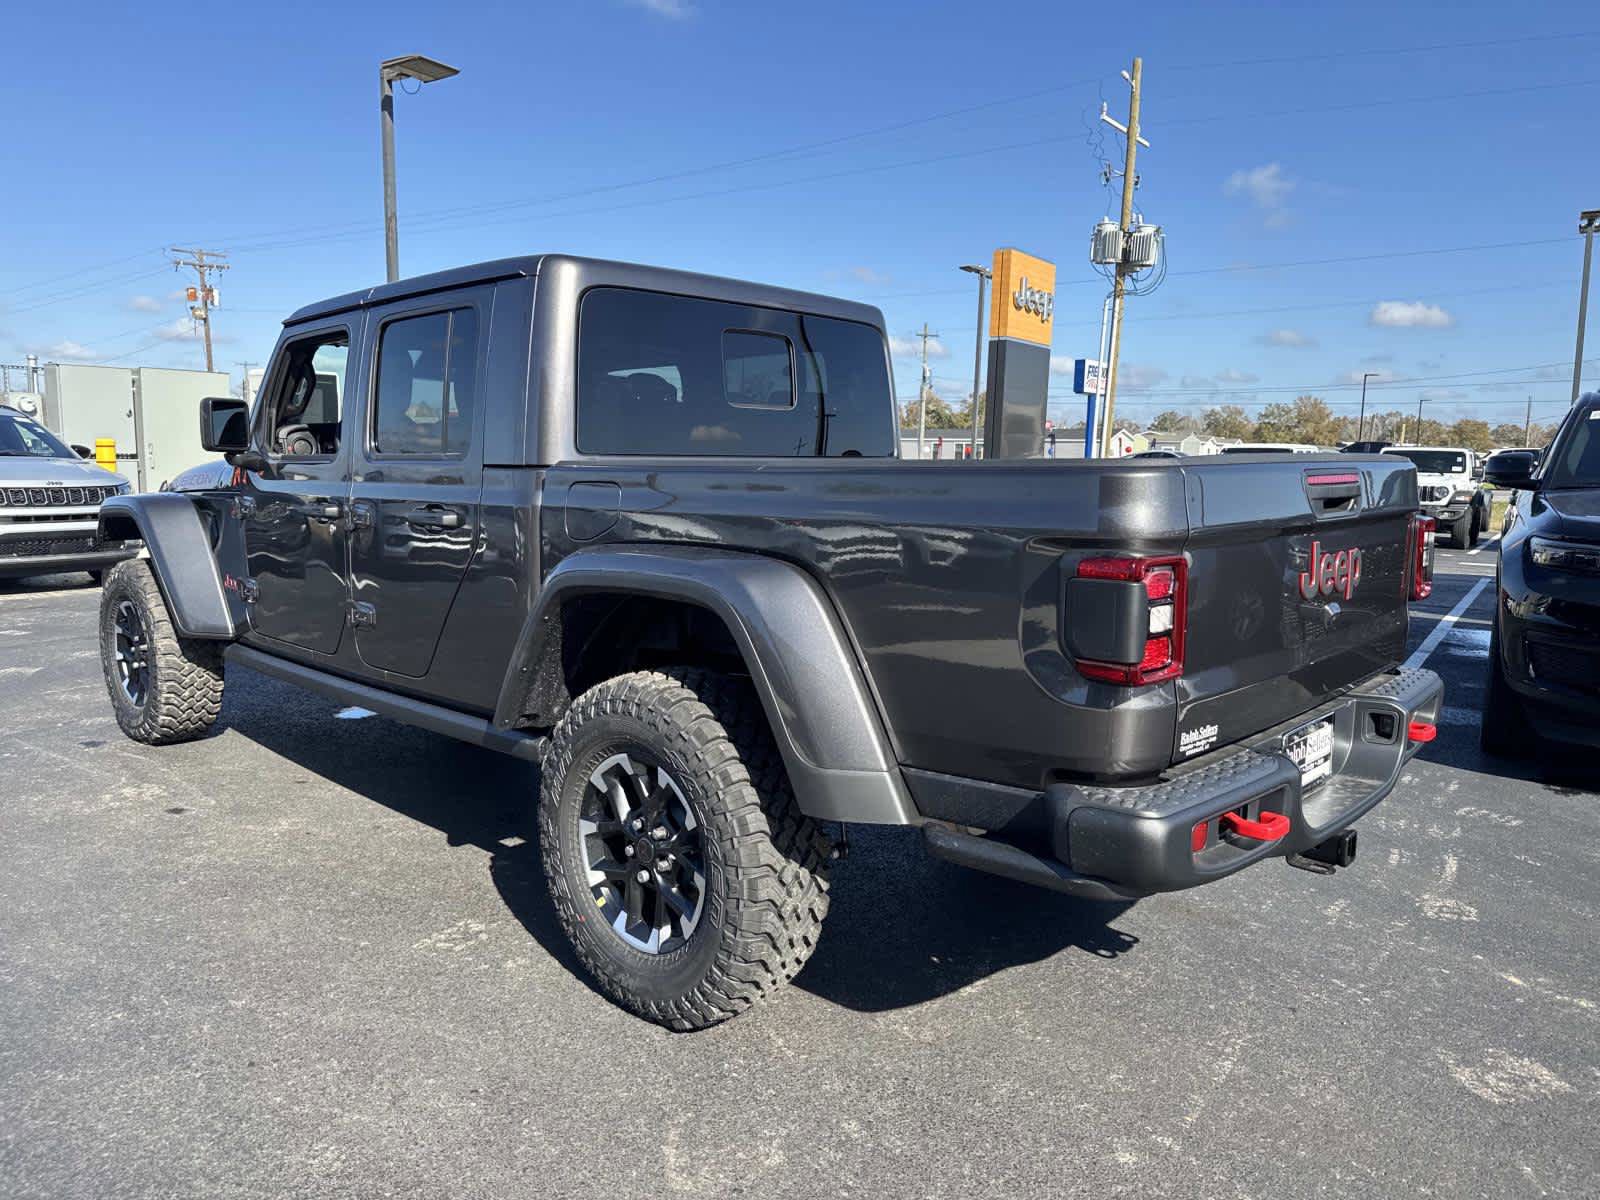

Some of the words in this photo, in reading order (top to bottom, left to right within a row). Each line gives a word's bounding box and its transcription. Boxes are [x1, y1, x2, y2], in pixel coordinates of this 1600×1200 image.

[1013, 276, 1054, 322] Jeep
[1299, 541, 1361, 601] Jeep
[1181, 729, 1198, 745] Ralph
